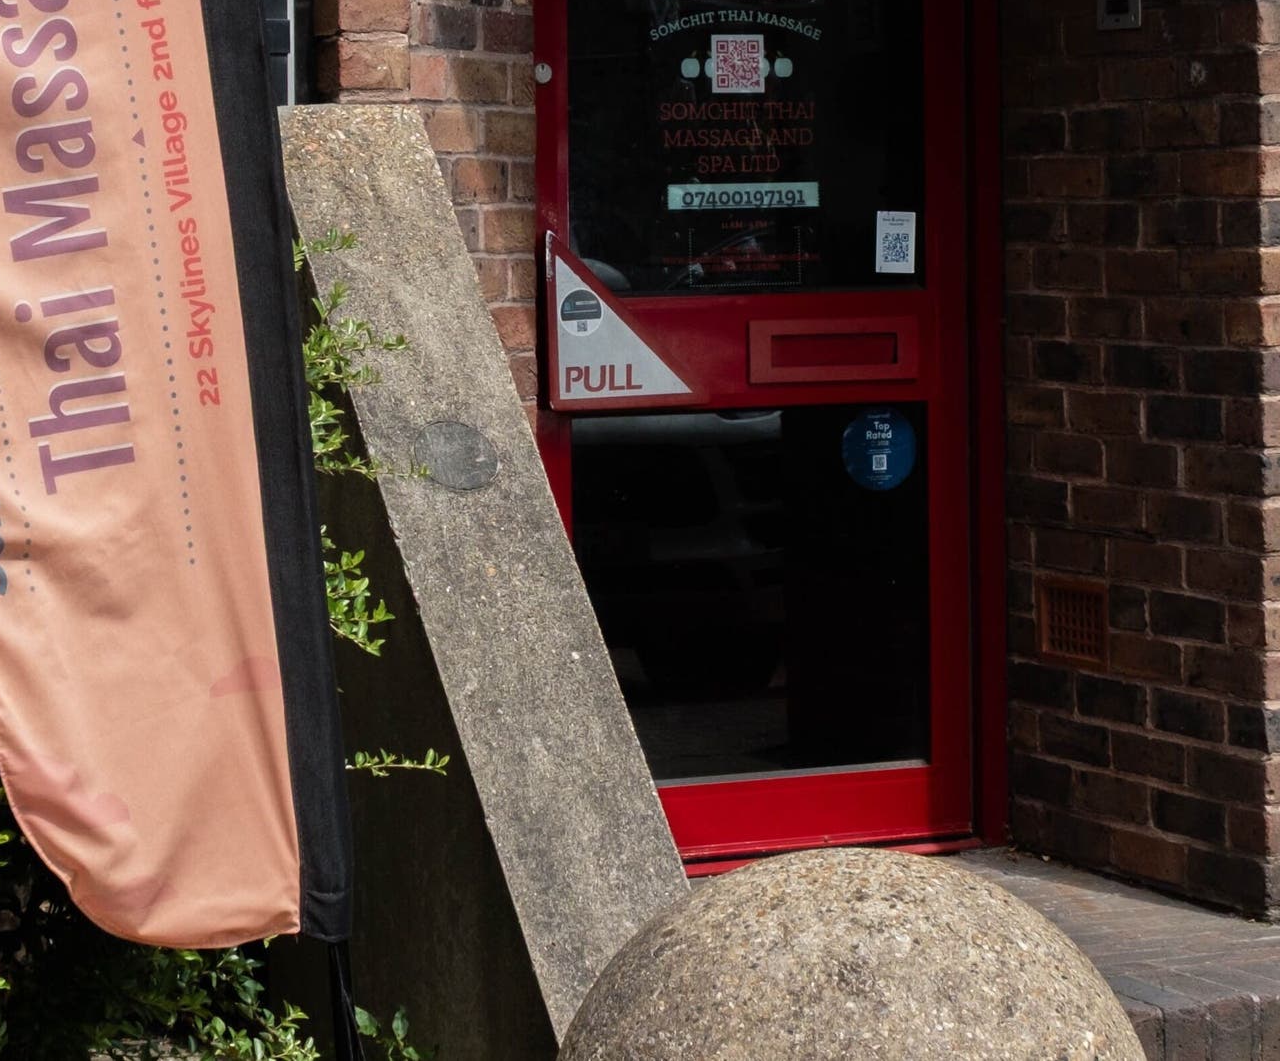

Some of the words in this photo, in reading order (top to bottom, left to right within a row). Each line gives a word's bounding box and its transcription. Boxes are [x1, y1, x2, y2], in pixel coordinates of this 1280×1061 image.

[650, 11, 715, 41] SOMCHIT
[718, 10, 754, 23] THAI
[757, 11, 823, 41] MASSAGE
[140, 18, 174, 81] 2nd
[658, 102, 760, 121] SOMCHIT
[763, 102, 816, 121] THAI
[158, 90, 193, 214] Village
[663, 128, 762, 148] MASSAGE
[767, 128, 814, 147] AND
[697, 154, 737, 174] SPA
[740, 154, 783, 174] LTD
[682, 190, 806, 208] 07400197191
[179, 218, 216, 361] Skylines
[15, 286, 136, 495] Thai
[197, 368, 221, 406] 22
[565, 364, 642, 393] PULL
[866, 430, 893, 440] Rated
[873, 421, 890, 431] Top
